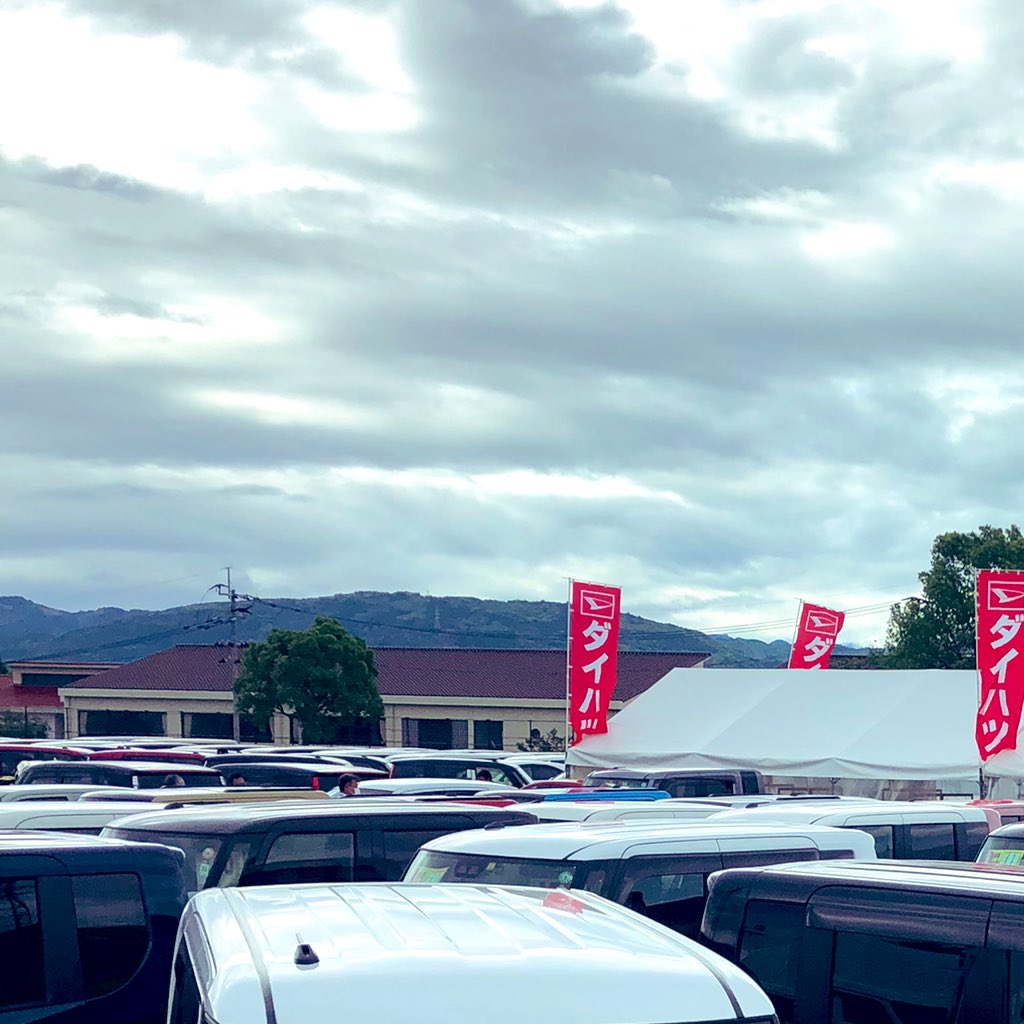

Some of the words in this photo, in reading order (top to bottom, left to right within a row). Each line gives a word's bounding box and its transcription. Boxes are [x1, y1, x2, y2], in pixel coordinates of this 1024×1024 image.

[803, 635, 834, 671] ダ
[978, 613, 1024, 753] ダイハツ
